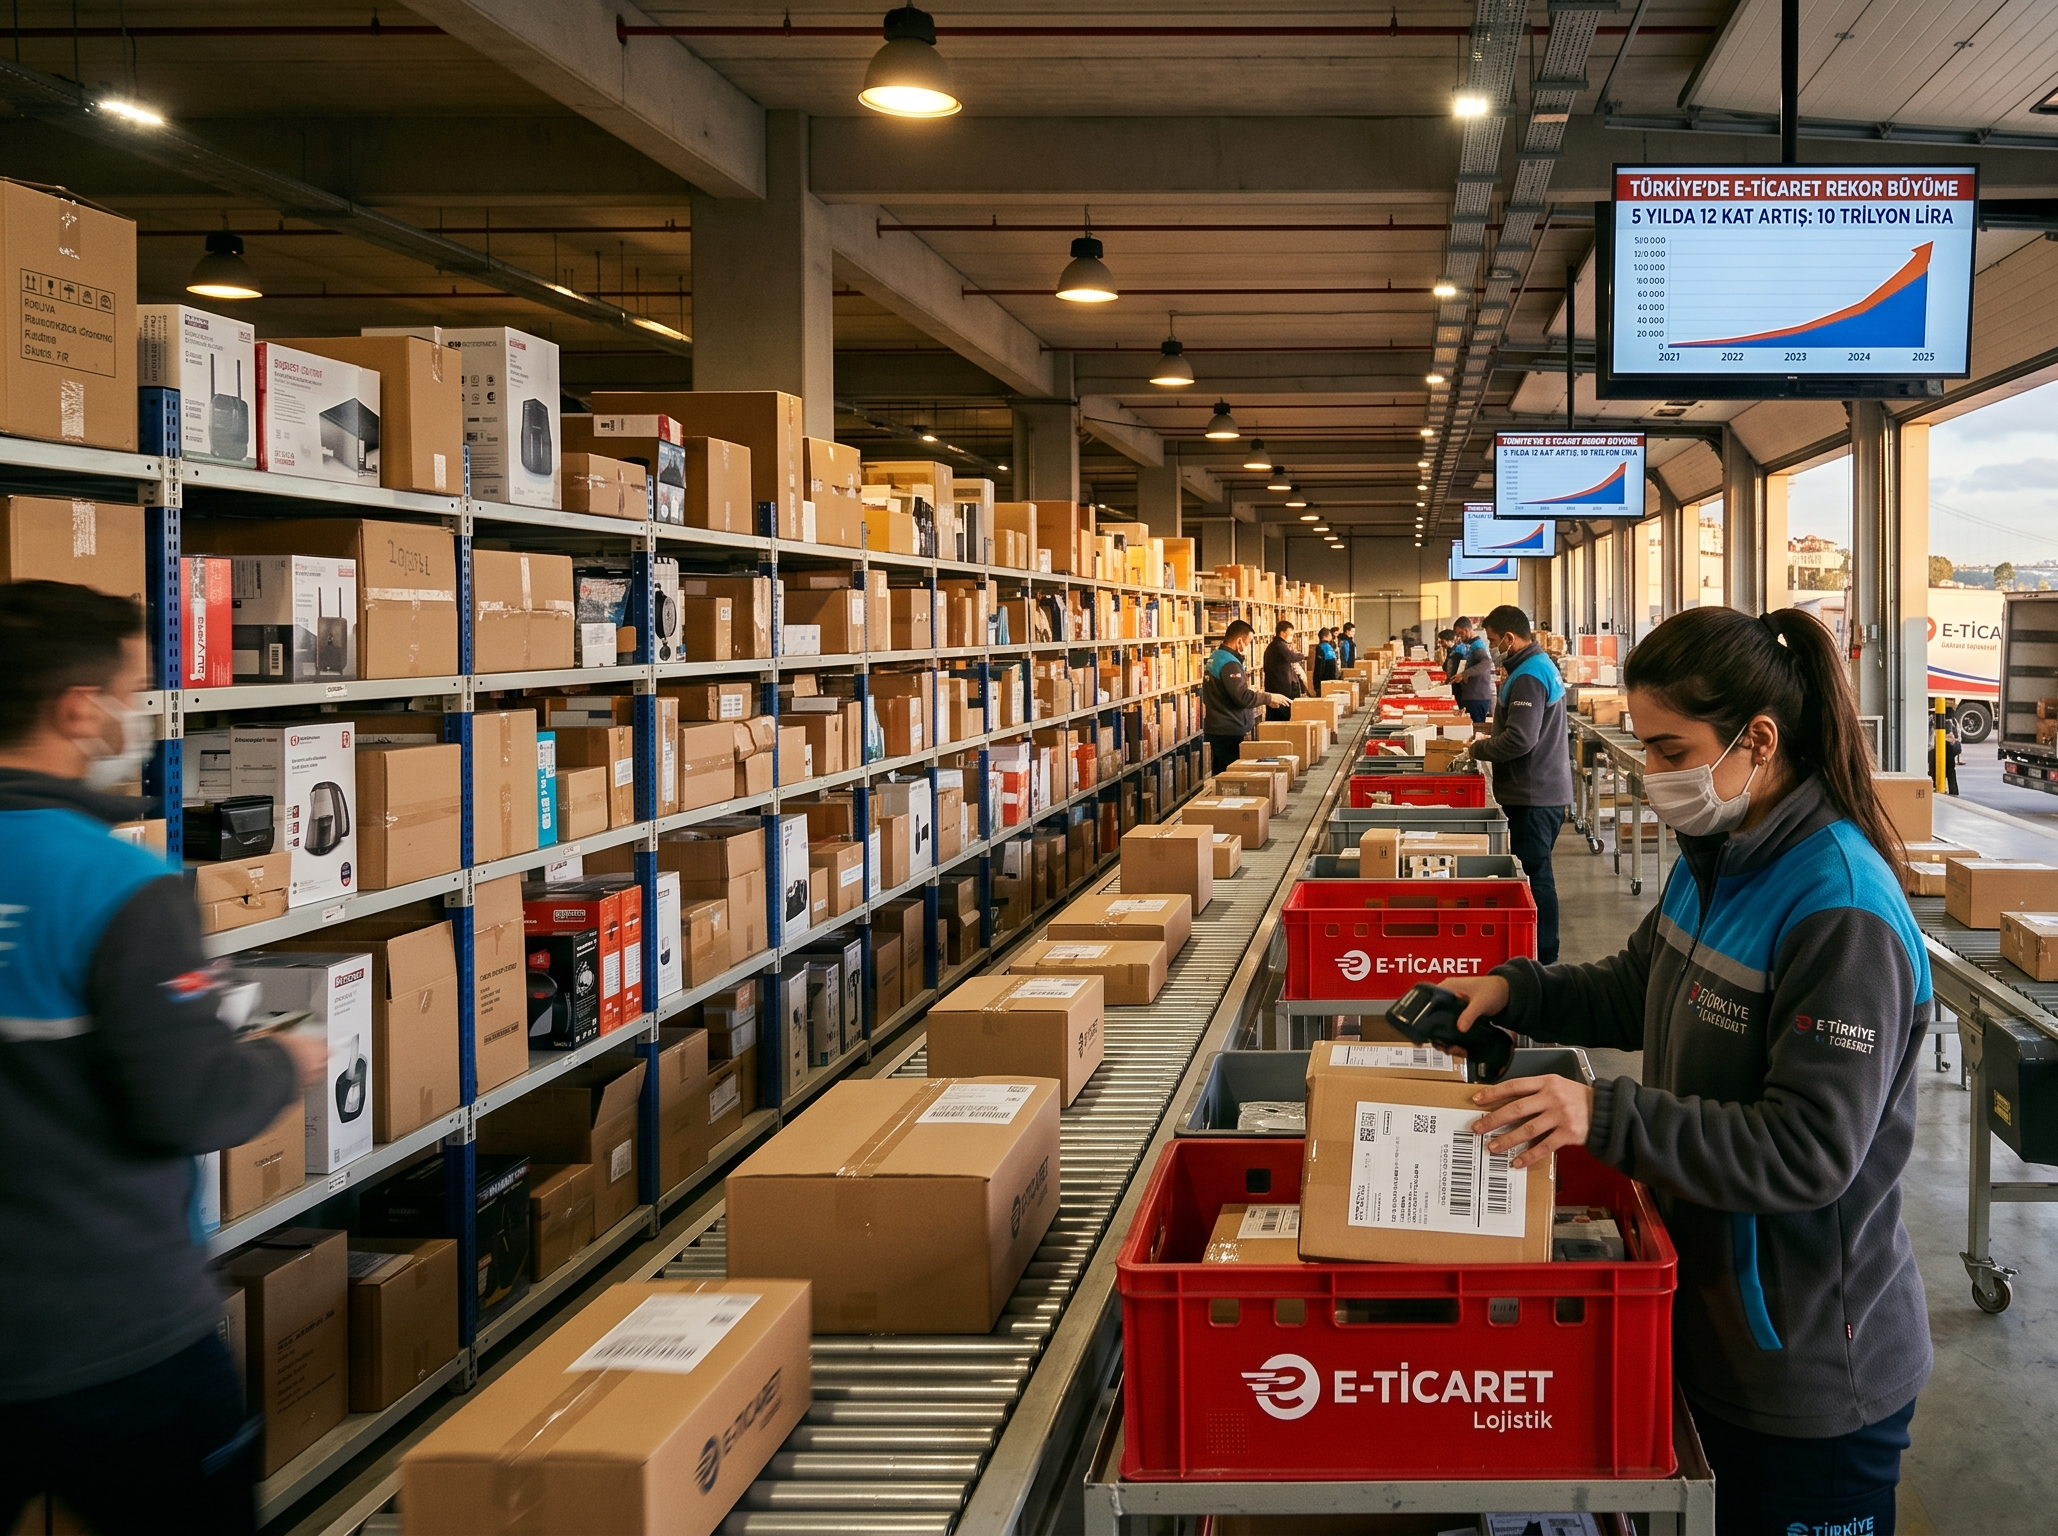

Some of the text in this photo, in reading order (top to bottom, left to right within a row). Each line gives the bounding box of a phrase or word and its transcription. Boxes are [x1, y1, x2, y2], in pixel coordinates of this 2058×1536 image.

[1630, 177, 1958, 197] TÜRKİYE'DE E-TİCARET REKOR BÜYÜME
[1631, 205, 1953, 228] 5 YILDA 12 KAT ARTIŞ: 10 TRİLYON LİRA
[1658, 352, 1935, 361] 2021 2022 2023 2024 2025
[1376, 953, 1482, 974] E-TİCARET
[1334, 1362, 1553, 1404] E-TİCARET
[1473, 1410, 1553, 1433] Lojistik
